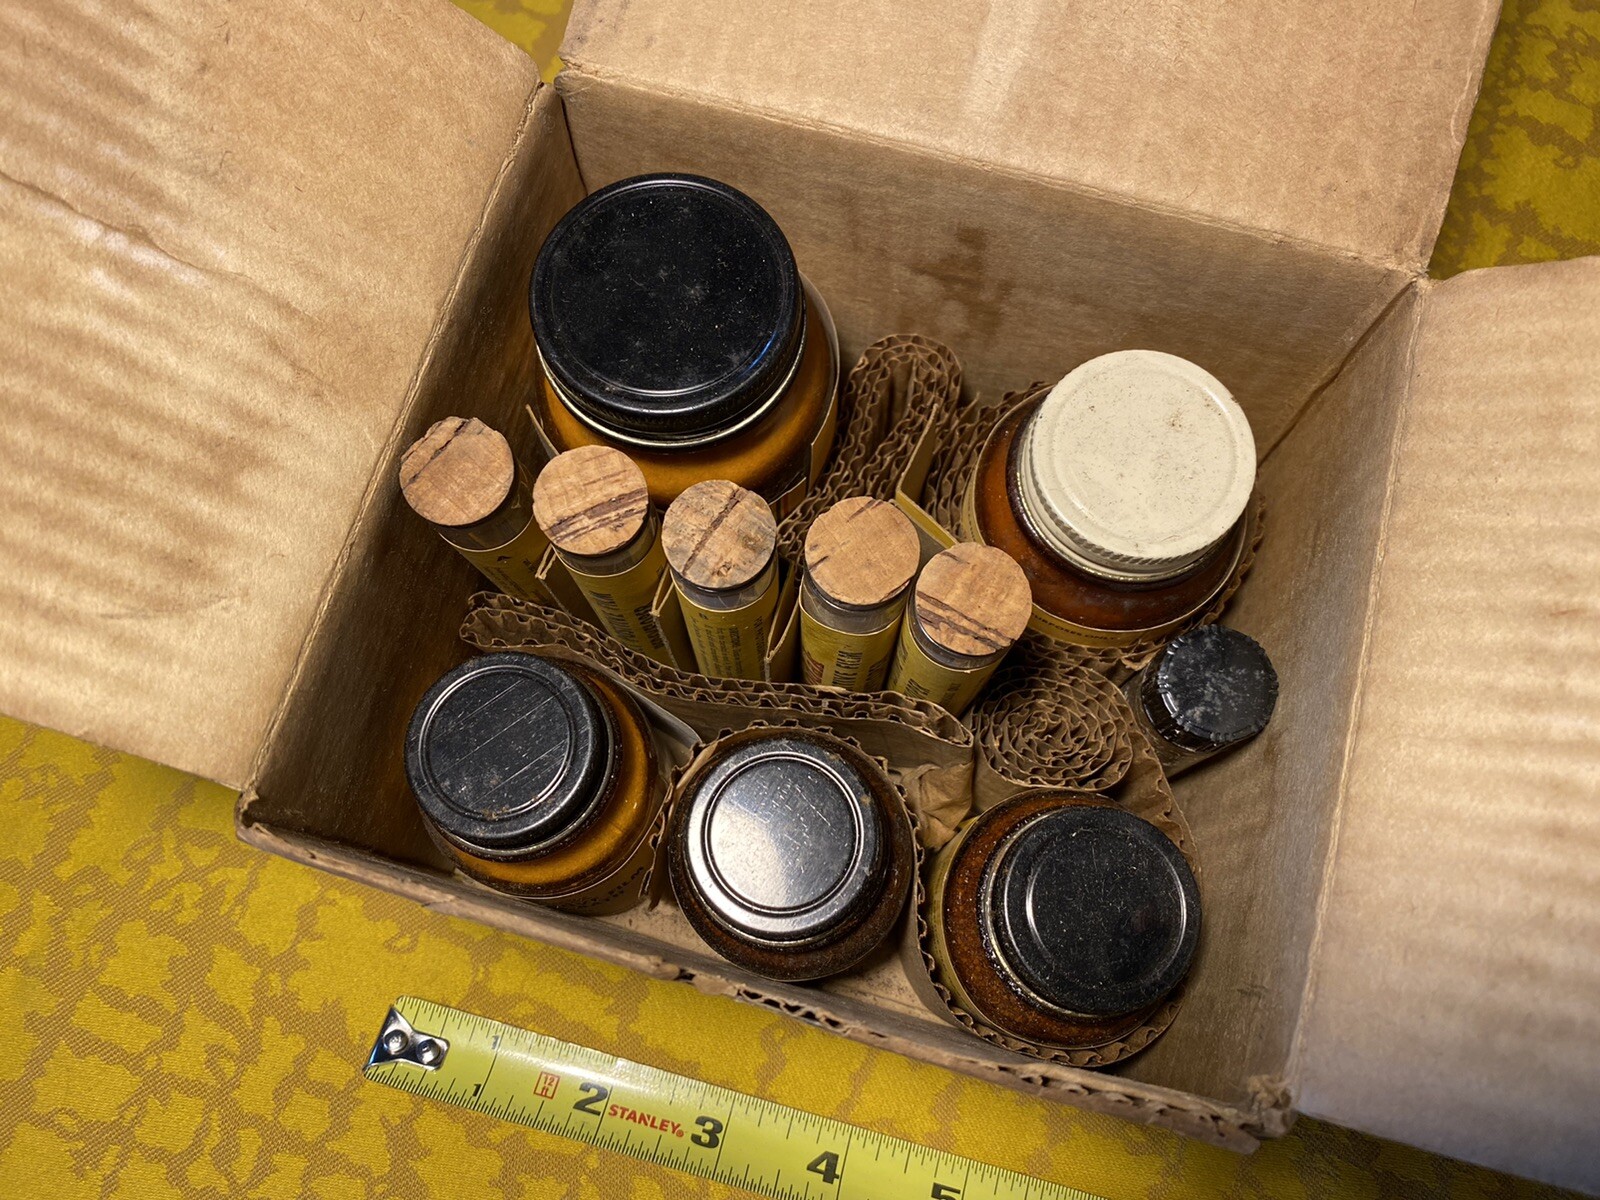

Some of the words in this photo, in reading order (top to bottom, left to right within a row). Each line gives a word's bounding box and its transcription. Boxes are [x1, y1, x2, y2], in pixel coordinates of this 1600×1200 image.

[491, 1034, 501, 1050] 1
[473, 1083, 484, 1097] 1
[543, 1074, 555, 1086] 12
[572, 1081, 609, 1117] 2
[608, 1104, 680, 1134] STANLEY
[690, 1115, 724, 1150] 3
[805, 1150, 840, 1186] 4
